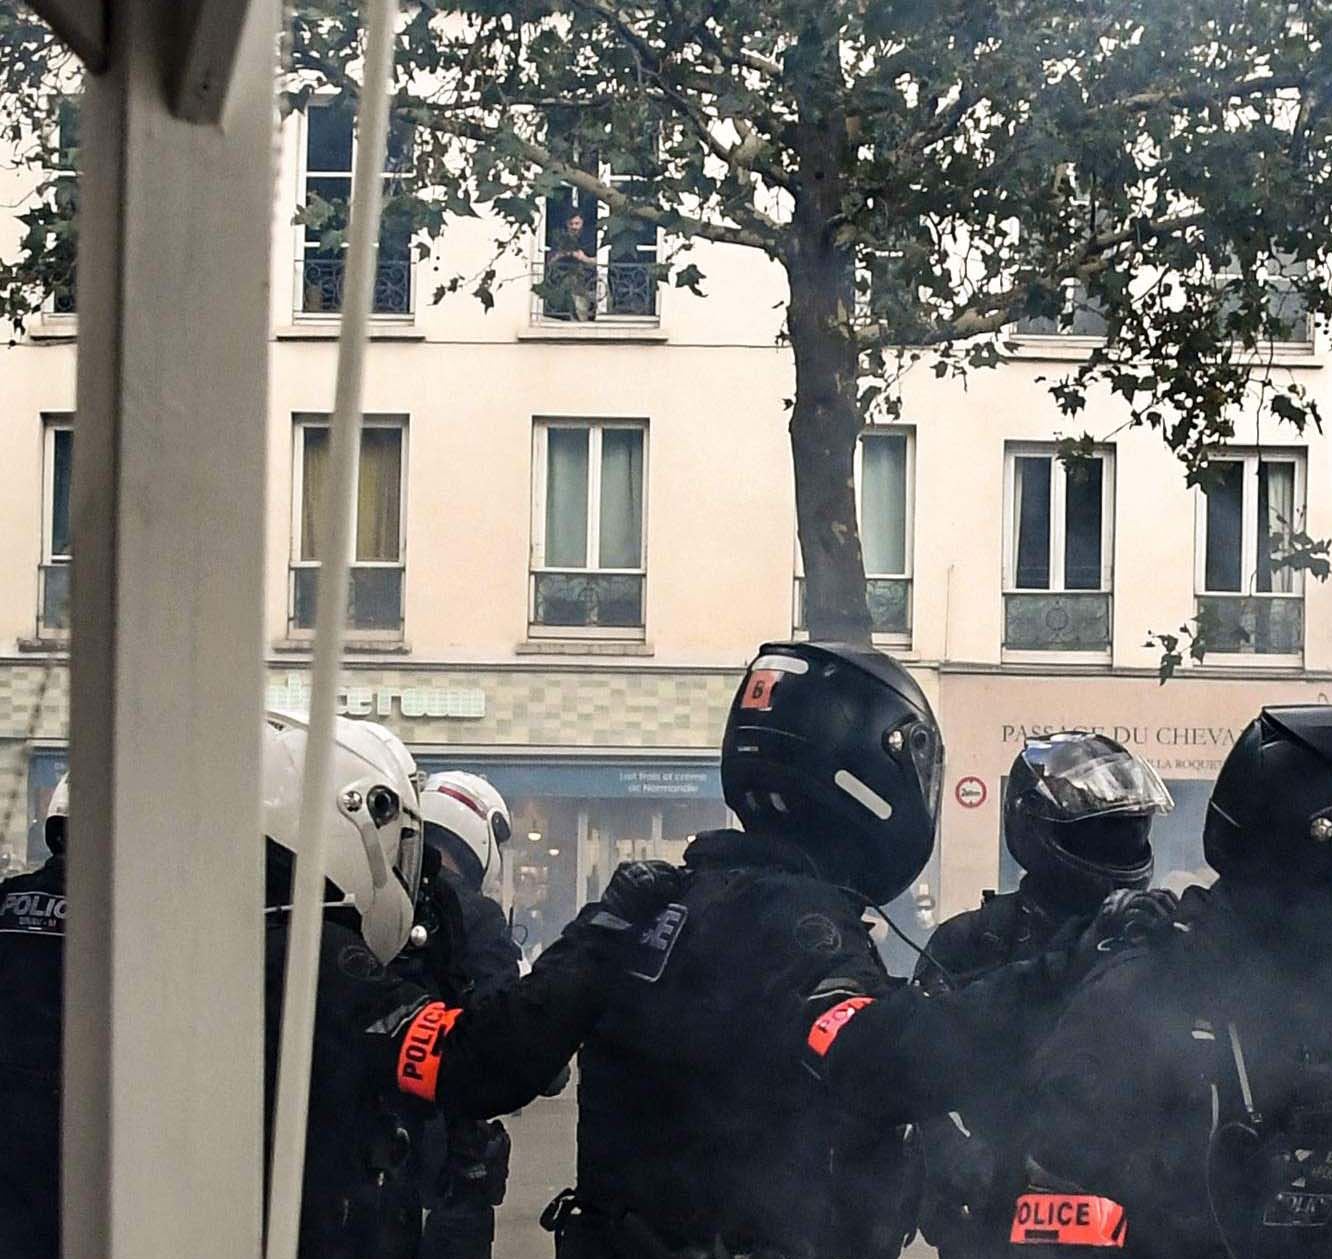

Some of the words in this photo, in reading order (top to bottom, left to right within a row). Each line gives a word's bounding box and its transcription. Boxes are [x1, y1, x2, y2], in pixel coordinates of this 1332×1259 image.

[1113, 727, 1147, 744] DU
[1156, 727, 1244, 745] CHEVA
[1018, 1202, 1090, 1226] OLICE
